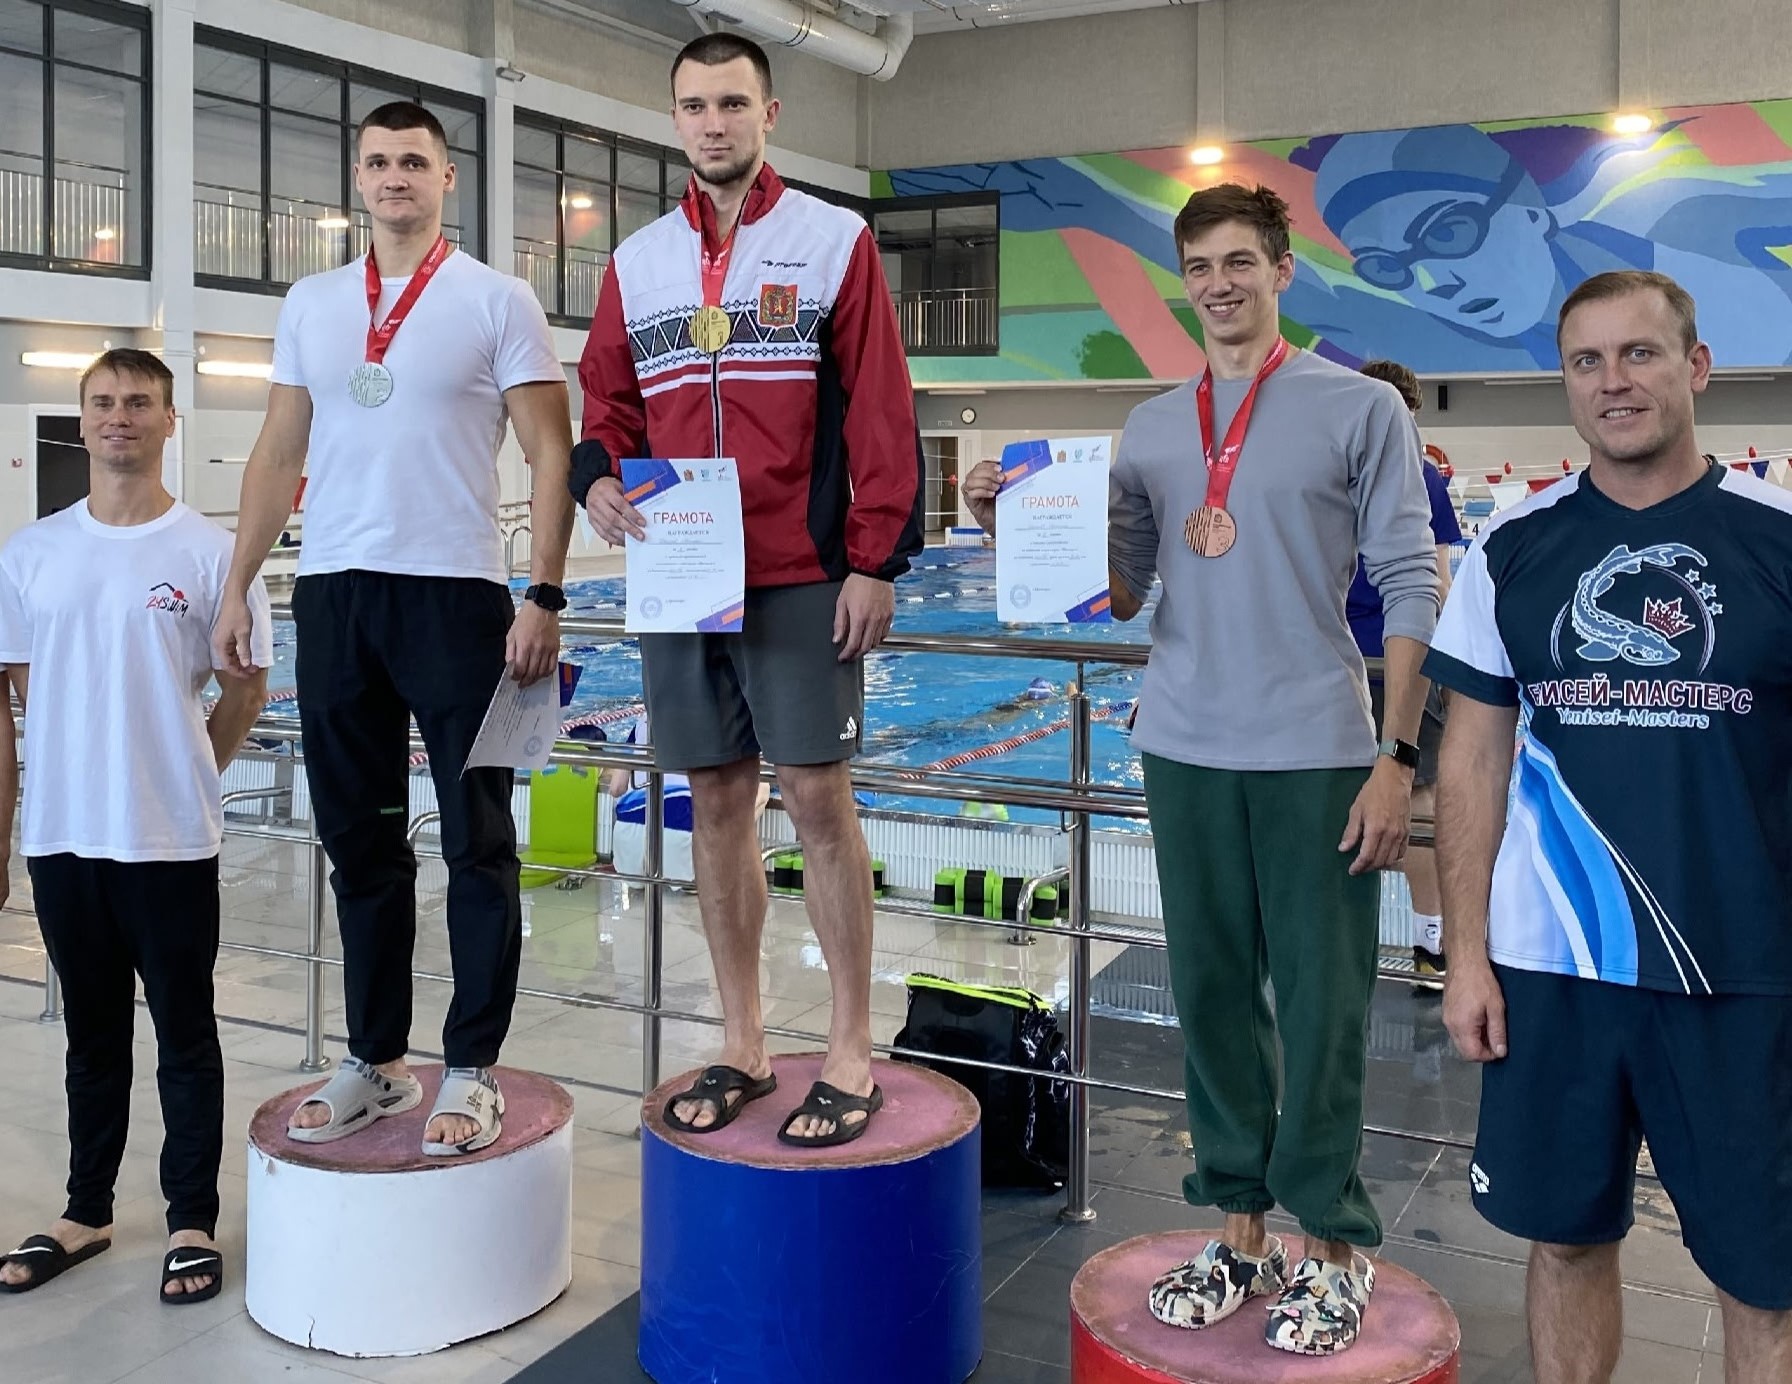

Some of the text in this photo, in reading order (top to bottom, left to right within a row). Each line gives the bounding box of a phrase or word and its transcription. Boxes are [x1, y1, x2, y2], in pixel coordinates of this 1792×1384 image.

[1022, 495, 1079, 509] ГРАМОТА
[653, 512, 714, 525] ГРАМОТА
[1471, 523, 1479, 536] 4
[1555, 707, 1710, 729] Yenisei-Masters
